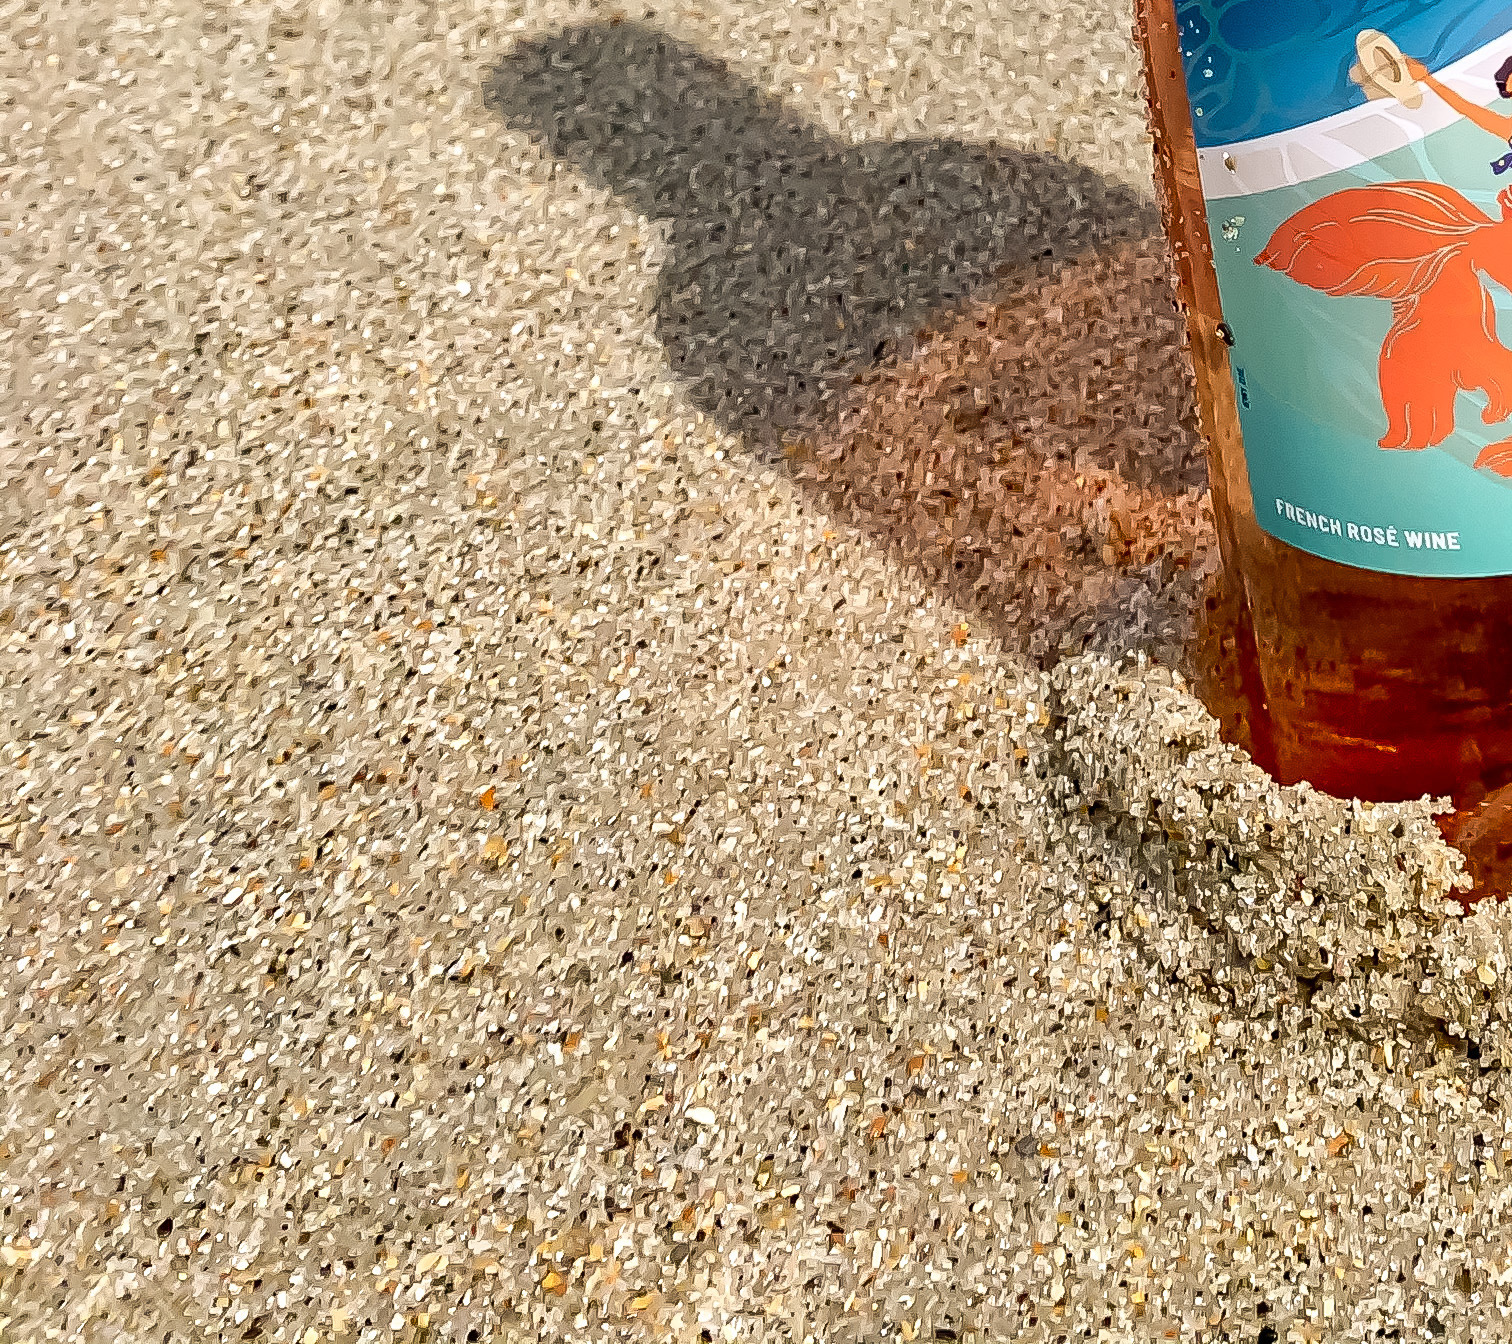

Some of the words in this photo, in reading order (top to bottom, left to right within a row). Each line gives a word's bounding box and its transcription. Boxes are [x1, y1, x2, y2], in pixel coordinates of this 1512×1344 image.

[1275, 498, 1342, 537] FRENCH
[1347, 522, 1399, 547] ROSÉ
[1403, 530, 1461, 550] WINE
